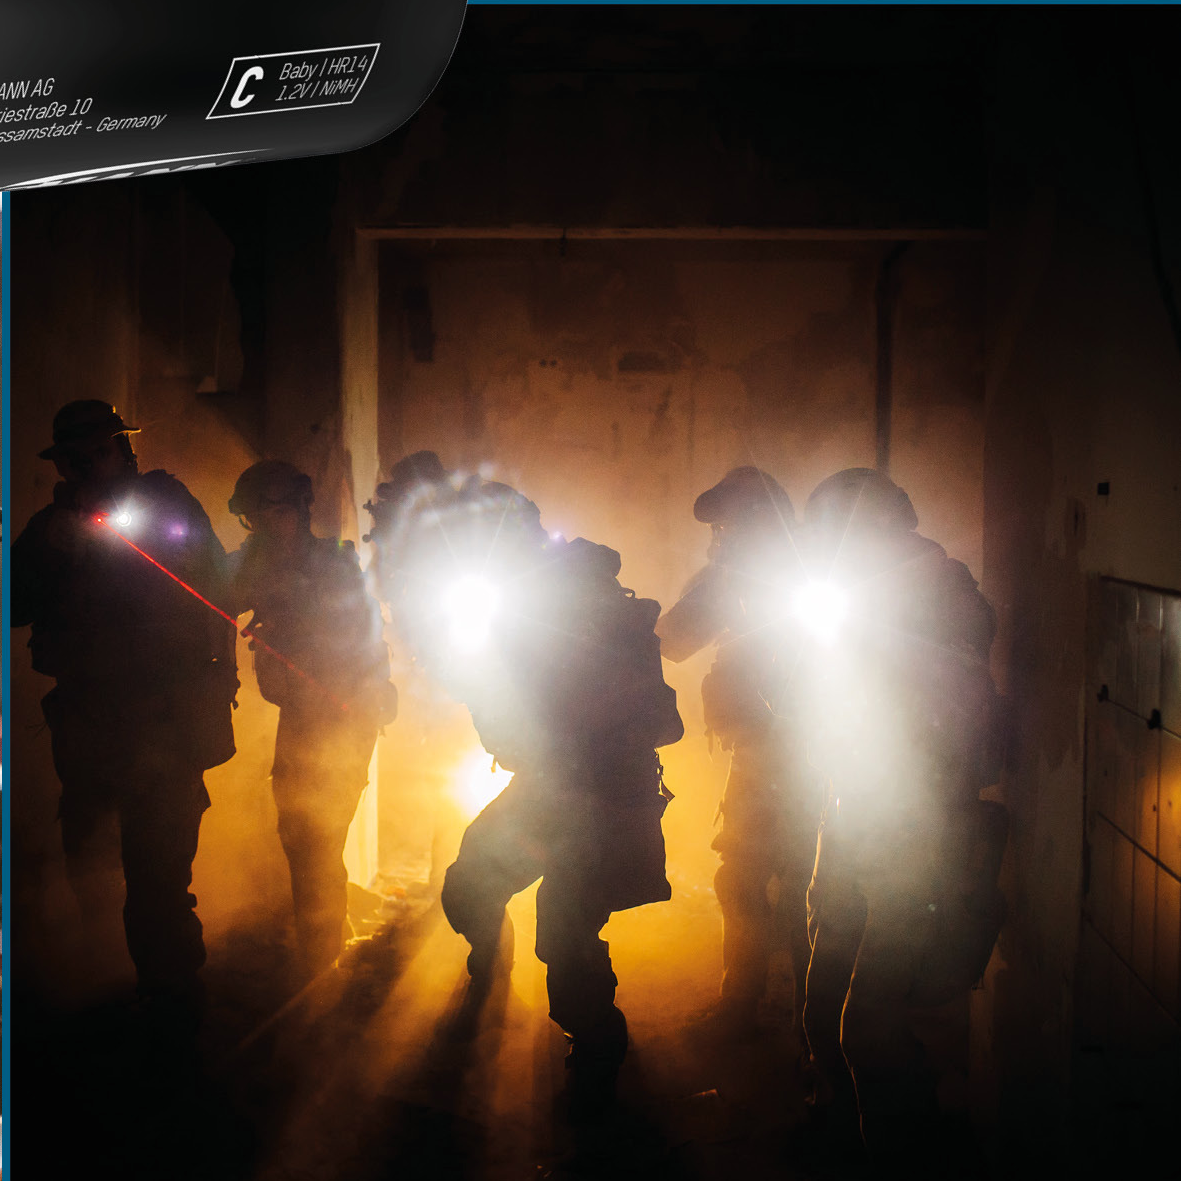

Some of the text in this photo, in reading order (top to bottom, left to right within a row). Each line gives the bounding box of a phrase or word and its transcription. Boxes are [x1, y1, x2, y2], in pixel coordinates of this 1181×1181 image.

[278, 61, 319, 82] Baby
[327, 54, 369, 75] HR14
[30, 77, 55, 98] AG
[230, 65, 264, 109] C
[274, 82, 312, 102] 1.2V
[319, 77, 360, 97] NiMH
[68, 97, 94, 117] 10
[95, 113, 168, 133] Germany
